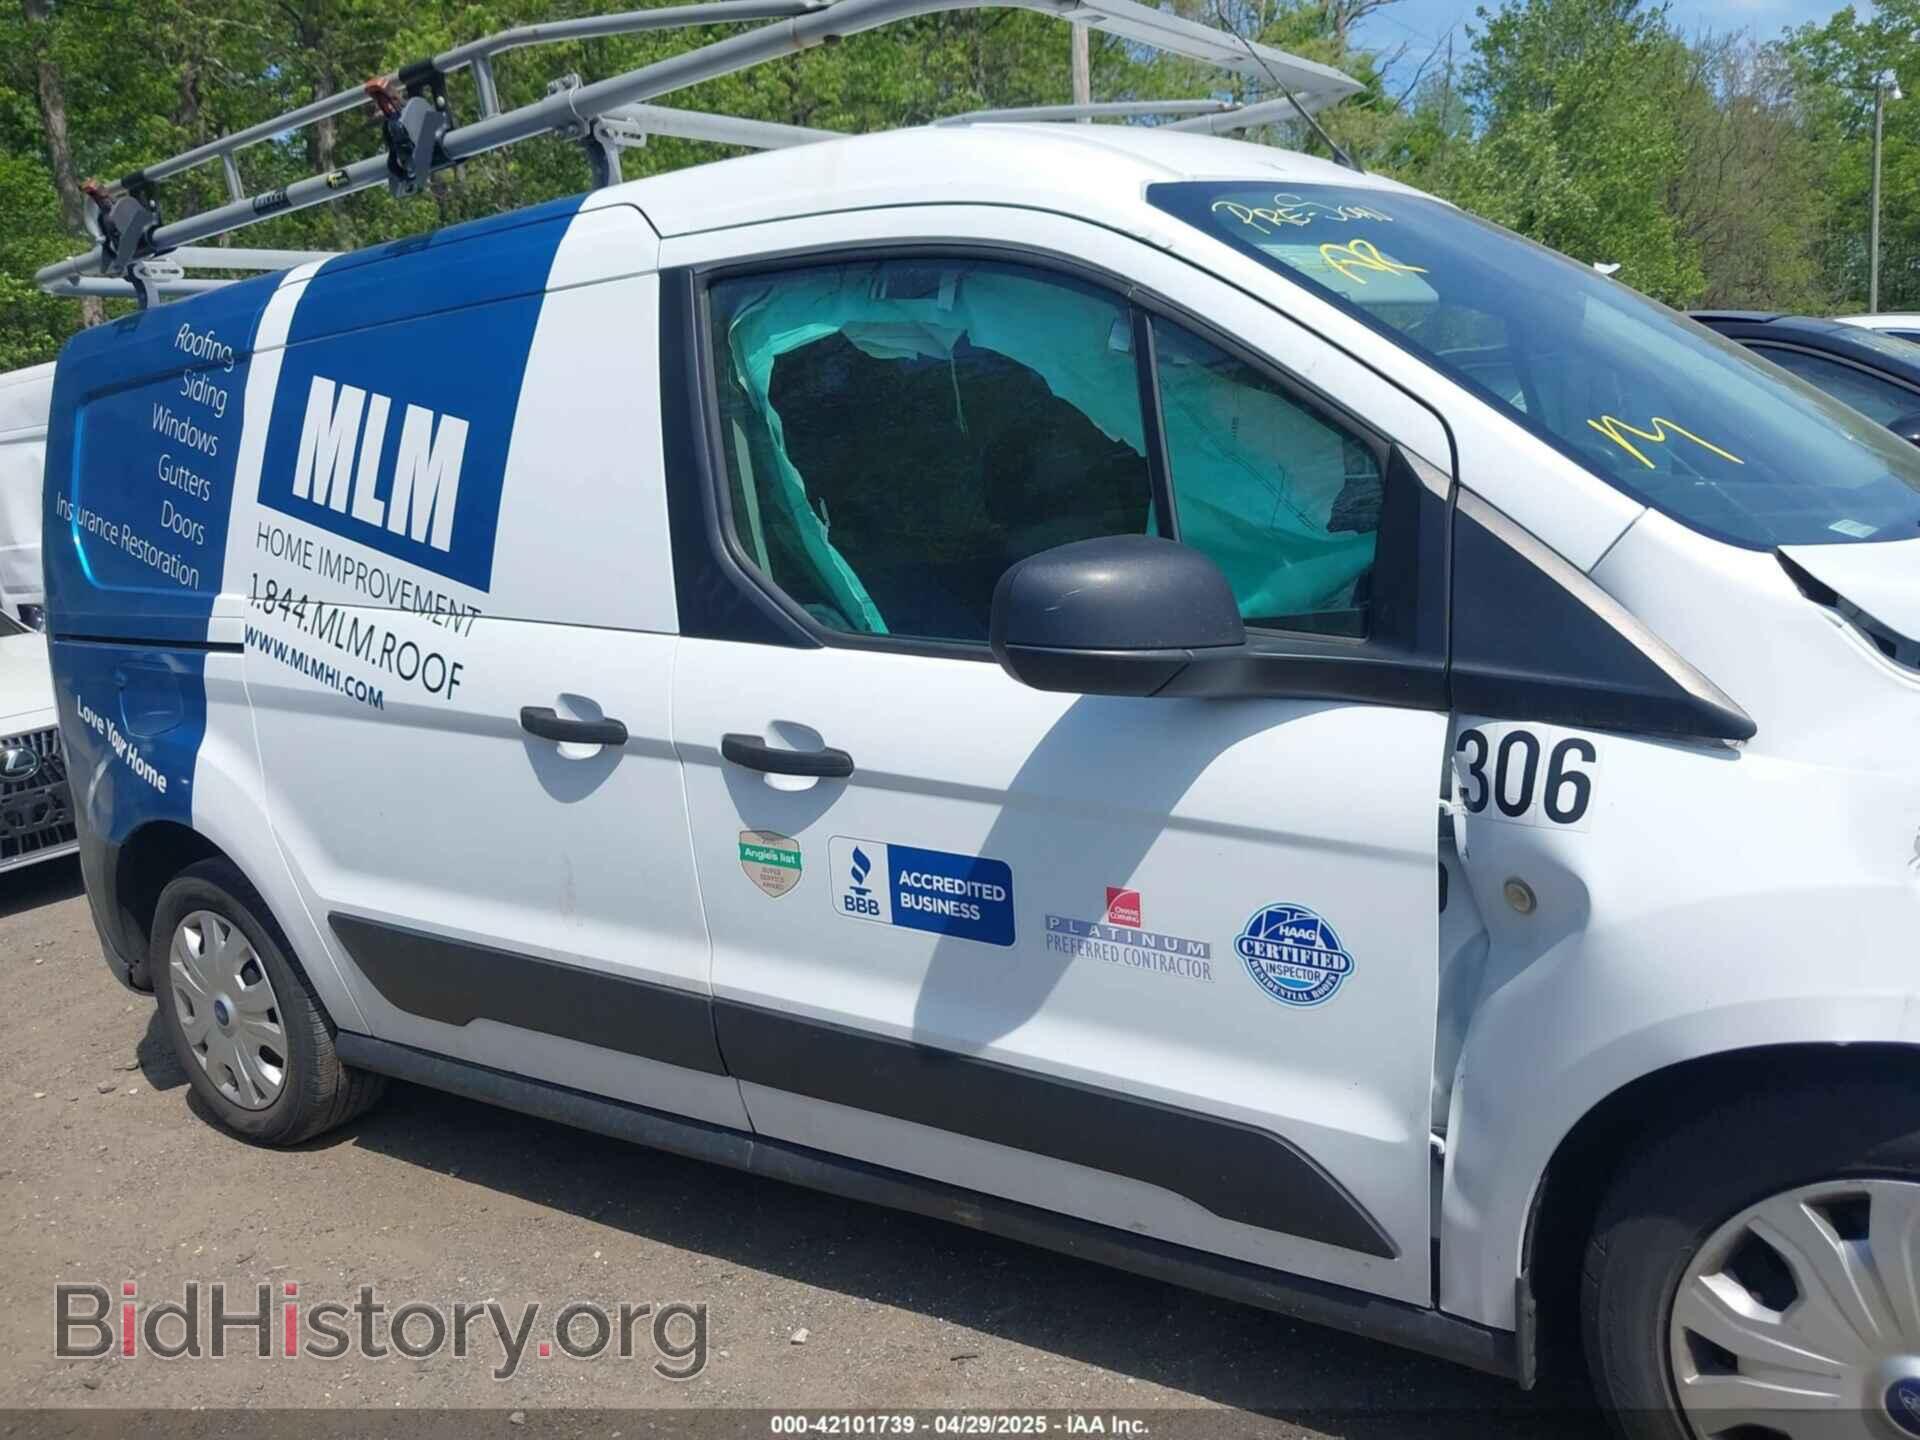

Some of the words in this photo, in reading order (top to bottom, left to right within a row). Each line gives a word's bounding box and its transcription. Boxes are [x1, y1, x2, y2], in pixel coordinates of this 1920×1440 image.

[174, 323, 234, 373] Roofing
[180, 369, 228, 418] Siding
[152, 402, 218, 457] Windows
[158, 454, 211, 501] Gutters
[292, 375, 470, 552] MLM
[56, 492, 118, 545] Insurance
[121, 524, 200, 590] Restoration
[161, 500, 205, 545] Doors
[256, 522, 314, 570] HOME
[318, 547, 482, 637] IMPROVEMENT
[250, 572, 463, 700] 1.844.MLM.ROOF
[244, 624, 385, 710] WWW.MLMHI.COM
[77, 695, 104, 735] Love
[105, 717, 127, 758] Your
[126, 743, 168, 793] Home
[1456, 729, 1597, 824] 306
[844, 895, 880, 916] BBB
[899, 870, 1006, 902] ACCREDITED
[901, 892, 981, 920] BUSINESS
[1046, 933, 1120, 963] PREFERRED
[1123, 947, 1212, 980] CONTRACTOR
[1050, 917, 1205, 957] PLATINUM
[1241, 938, 1347, 969] CERTIFIED
[1279, 925, 1316, 940] HAAG
[1265, 961, 1321, 982] INSPECTOR
